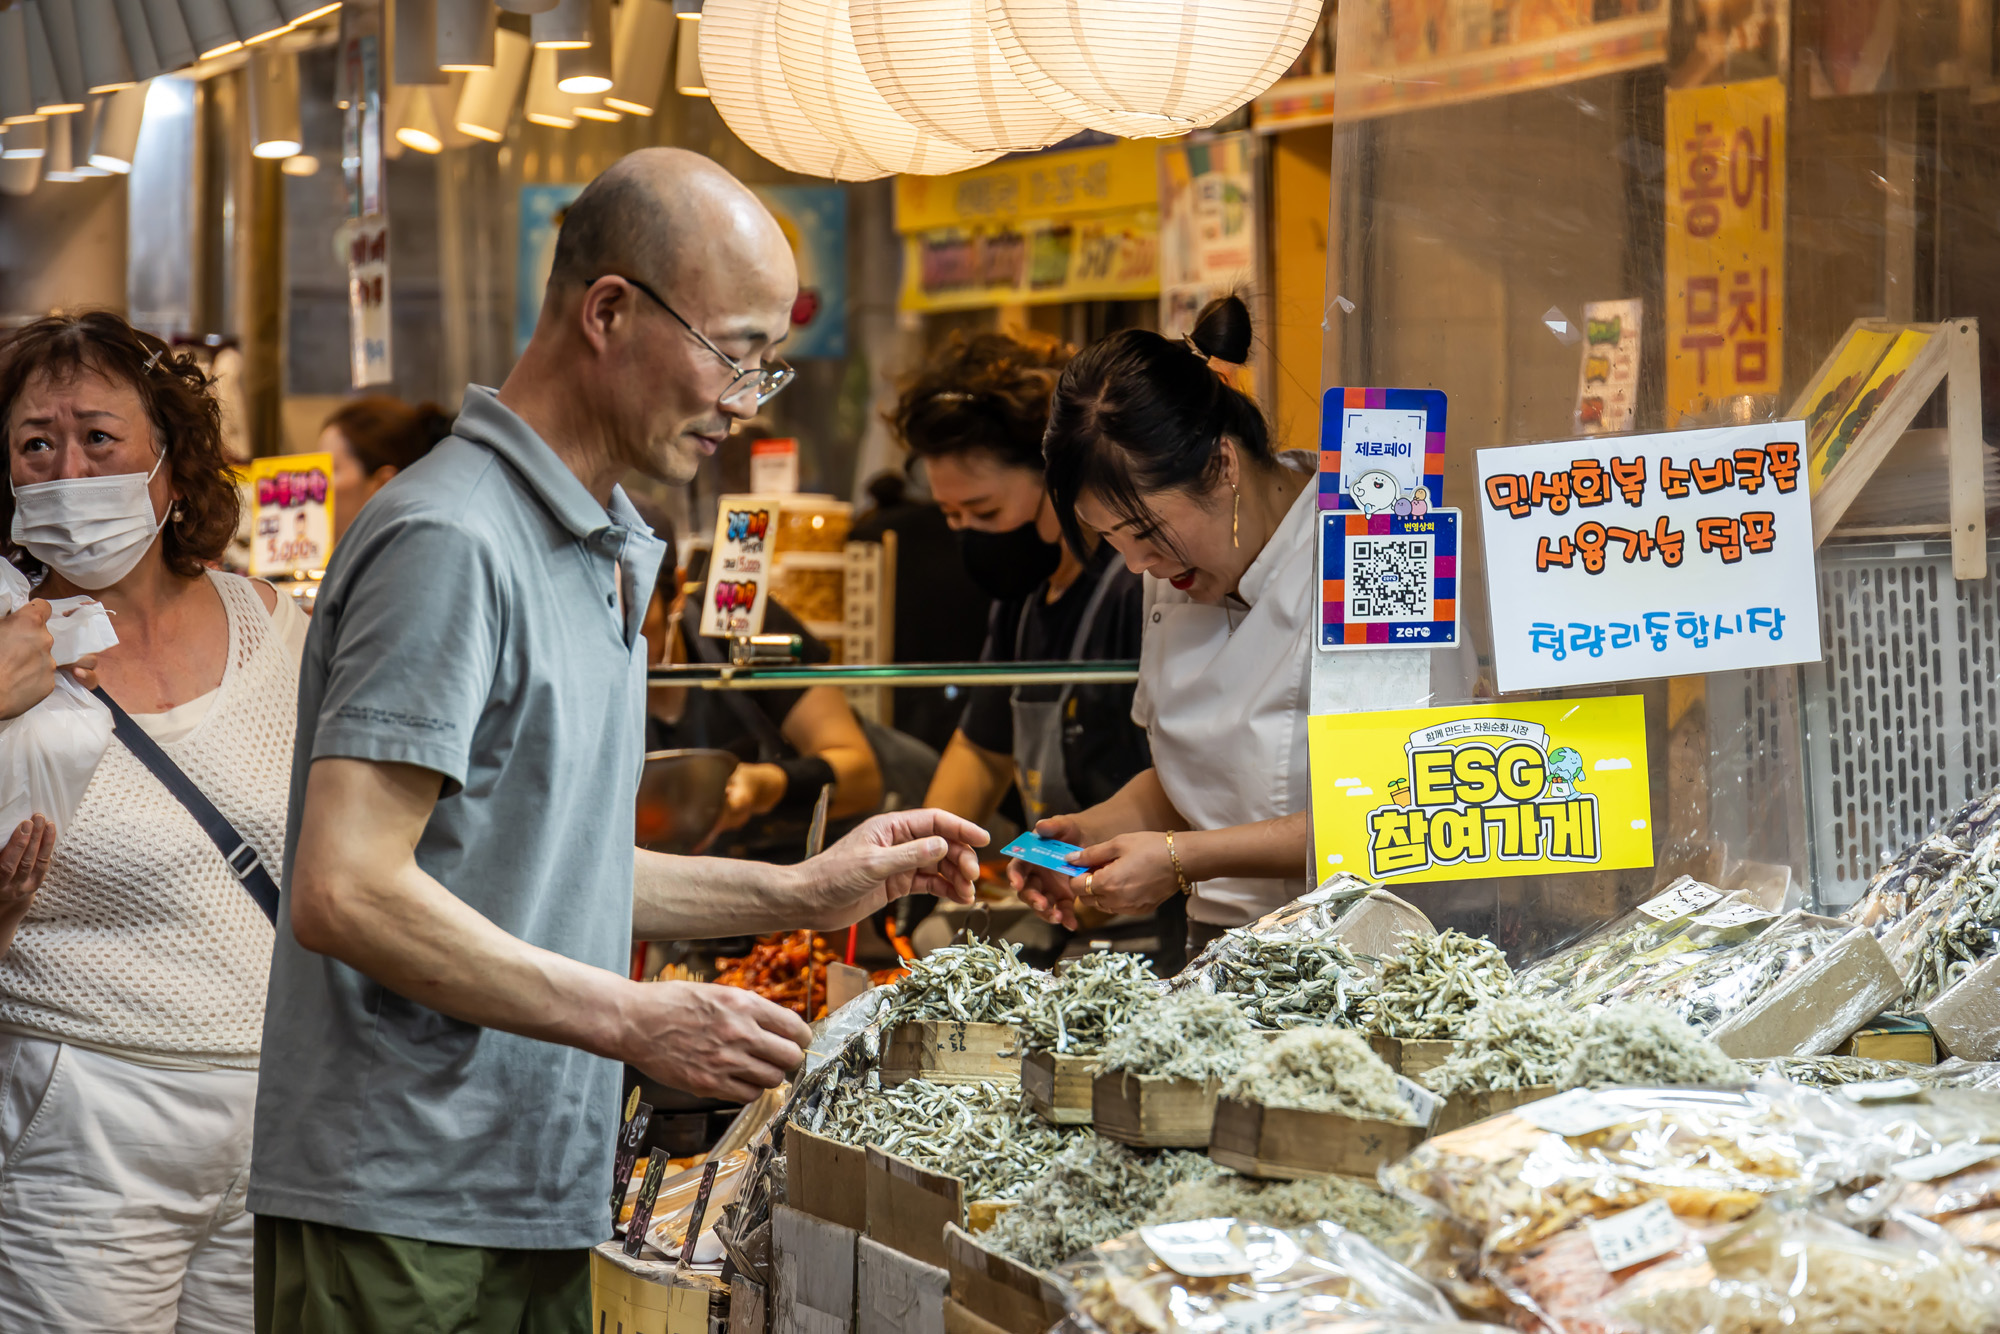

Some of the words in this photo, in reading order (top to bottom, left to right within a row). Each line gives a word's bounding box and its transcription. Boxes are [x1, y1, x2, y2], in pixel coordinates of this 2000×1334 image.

[1354, 442, 1412, 458] 제로페이
[1485, 456, 1647, 519] 민생회복
[1660, 442, 1799, 499] 소비쿠폰
[1404, 522, 1435, 532] 번영상회
[1536, 516, 1684, 575] 사용가능
[1697, 511, 1776, 564] 점포
[1528, 607, 1786, 661] 청량리종합시장
[1425, 729, 1444, 742] 함께
[1444, 724, 1471, 737] 만드는
[1473, 721, 1509, 733] 자원순화
[1510, 724, 1529, 736] 시장
[1412, 742, 1547, 806] ESG
[1371, 798, 1597, 875] 참여가게
